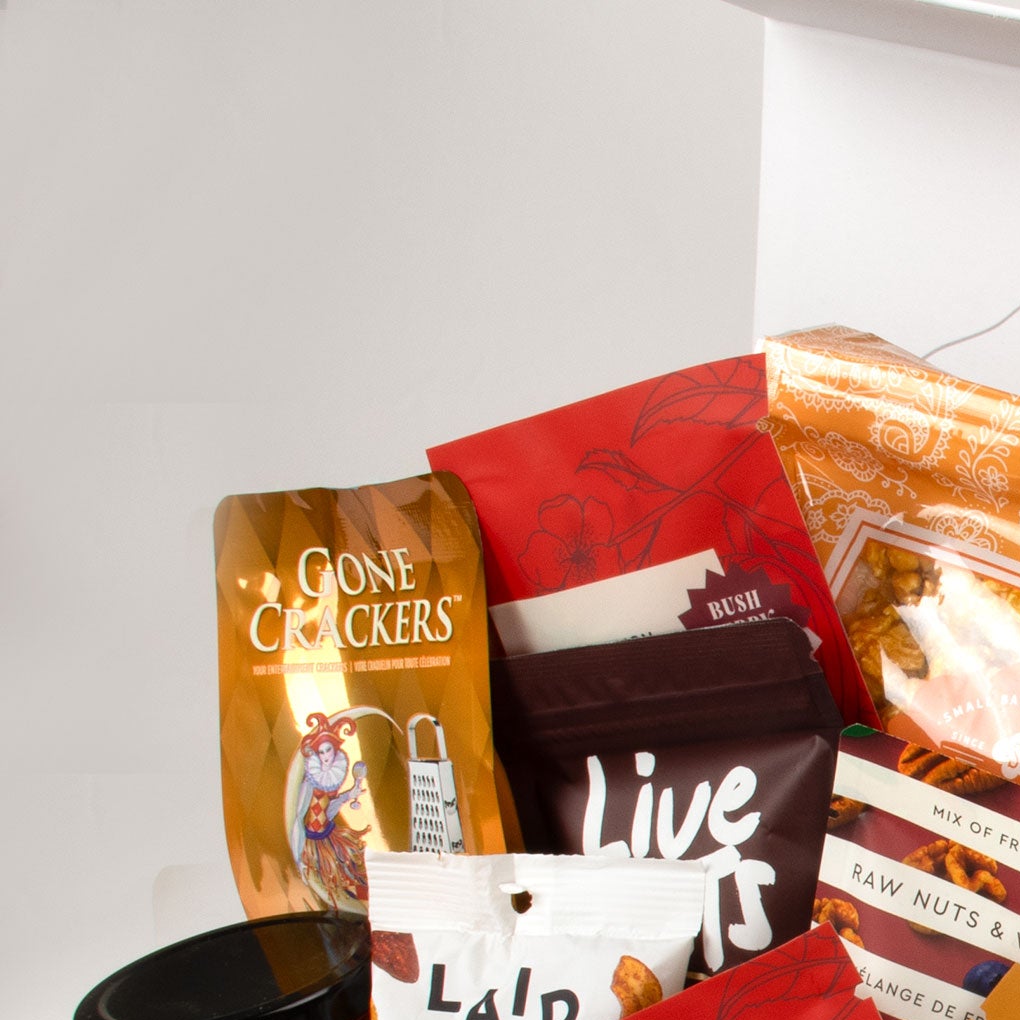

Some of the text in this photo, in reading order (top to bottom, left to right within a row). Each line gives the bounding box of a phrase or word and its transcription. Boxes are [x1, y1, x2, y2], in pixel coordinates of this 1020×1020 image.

[298, 547, 416, 598] GONE
[707, 589, 761, 621] BUSH
[943, 697, 993, 724] SMALL
[951, 731, 985, 750] SINCE
[582, 752, 761, 859] Live
[932, 804, 963, 827] MIX
[970, 820, 993, 839] OF
[697, 845, 776, 972] TS
[852, 862, 904, 898] RAW
[912, 888, 981, 929] NUTS
[990, 921, 1005, 940] &
[858, 966, 957, 1019] ÉLANGE DE
